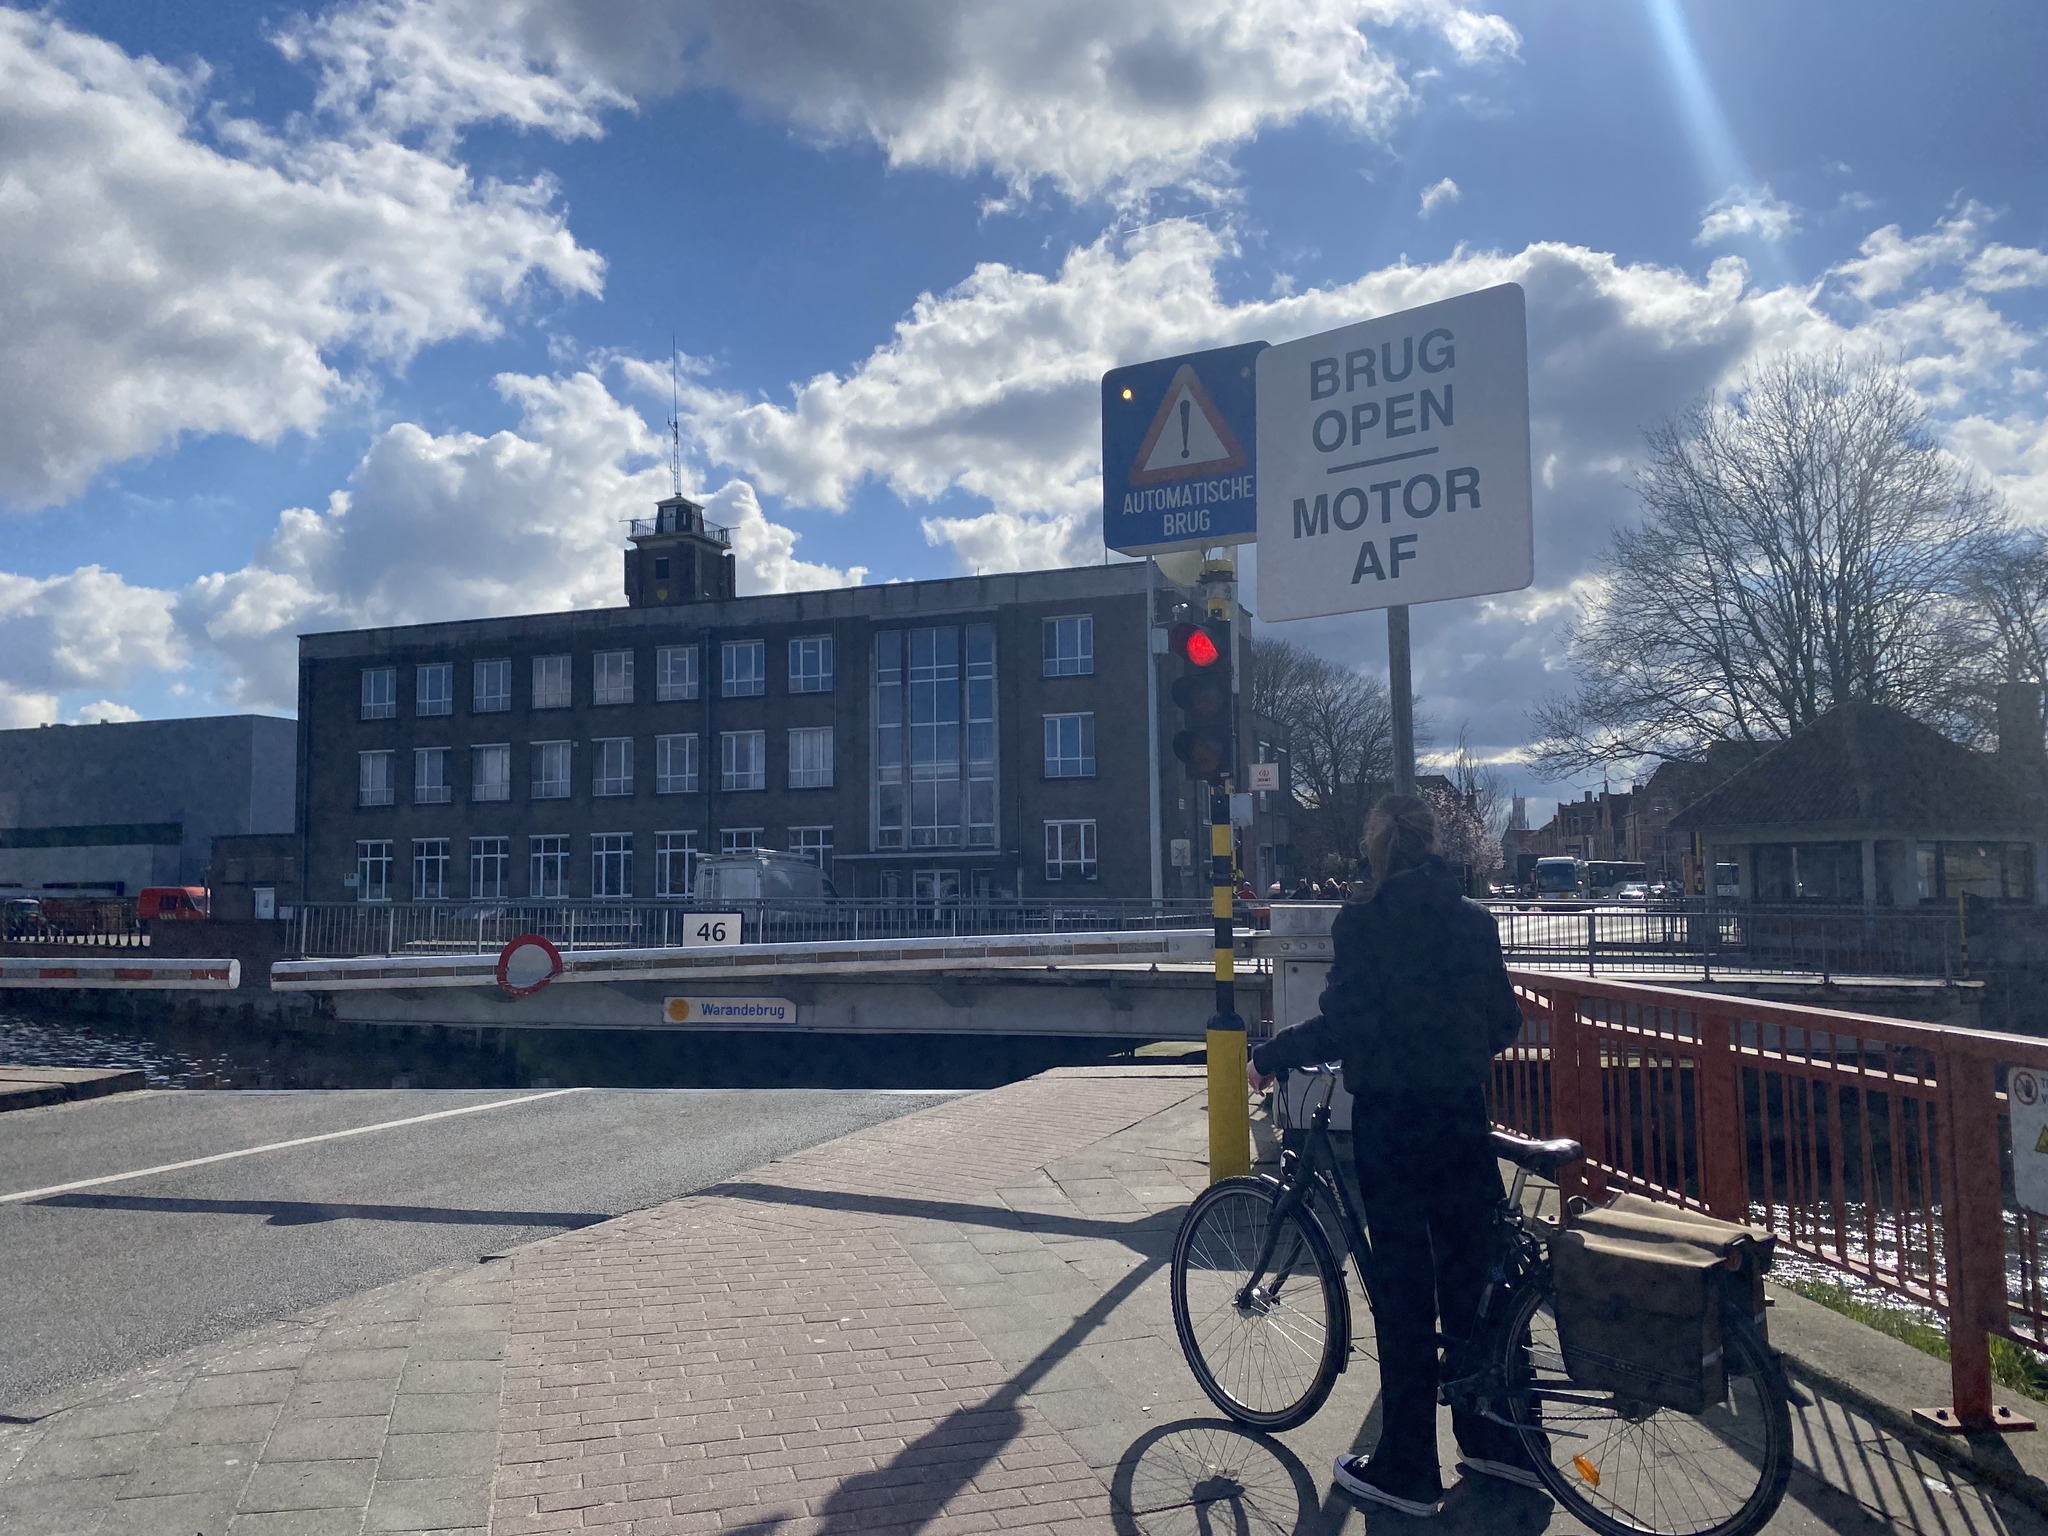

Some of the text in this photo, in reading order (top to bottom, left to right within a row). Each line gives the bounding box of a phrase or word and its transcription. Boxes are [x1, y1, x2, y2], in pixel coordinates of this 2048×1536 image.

[1310, 328, 1456, 402] BRUG
[1311, 384, 1455, 453] OPEN
[1122, 475, 1254, 515] AUTOMATISCHE
[1293, 466, 1482, 539] MOTOR
[1163, 509, 1211, 536] BRUG
[1350, 533, 1419, 584] AF
[696, 922, 727, 942] 46
[701, 1003, 785, 1019] Warandebrug
